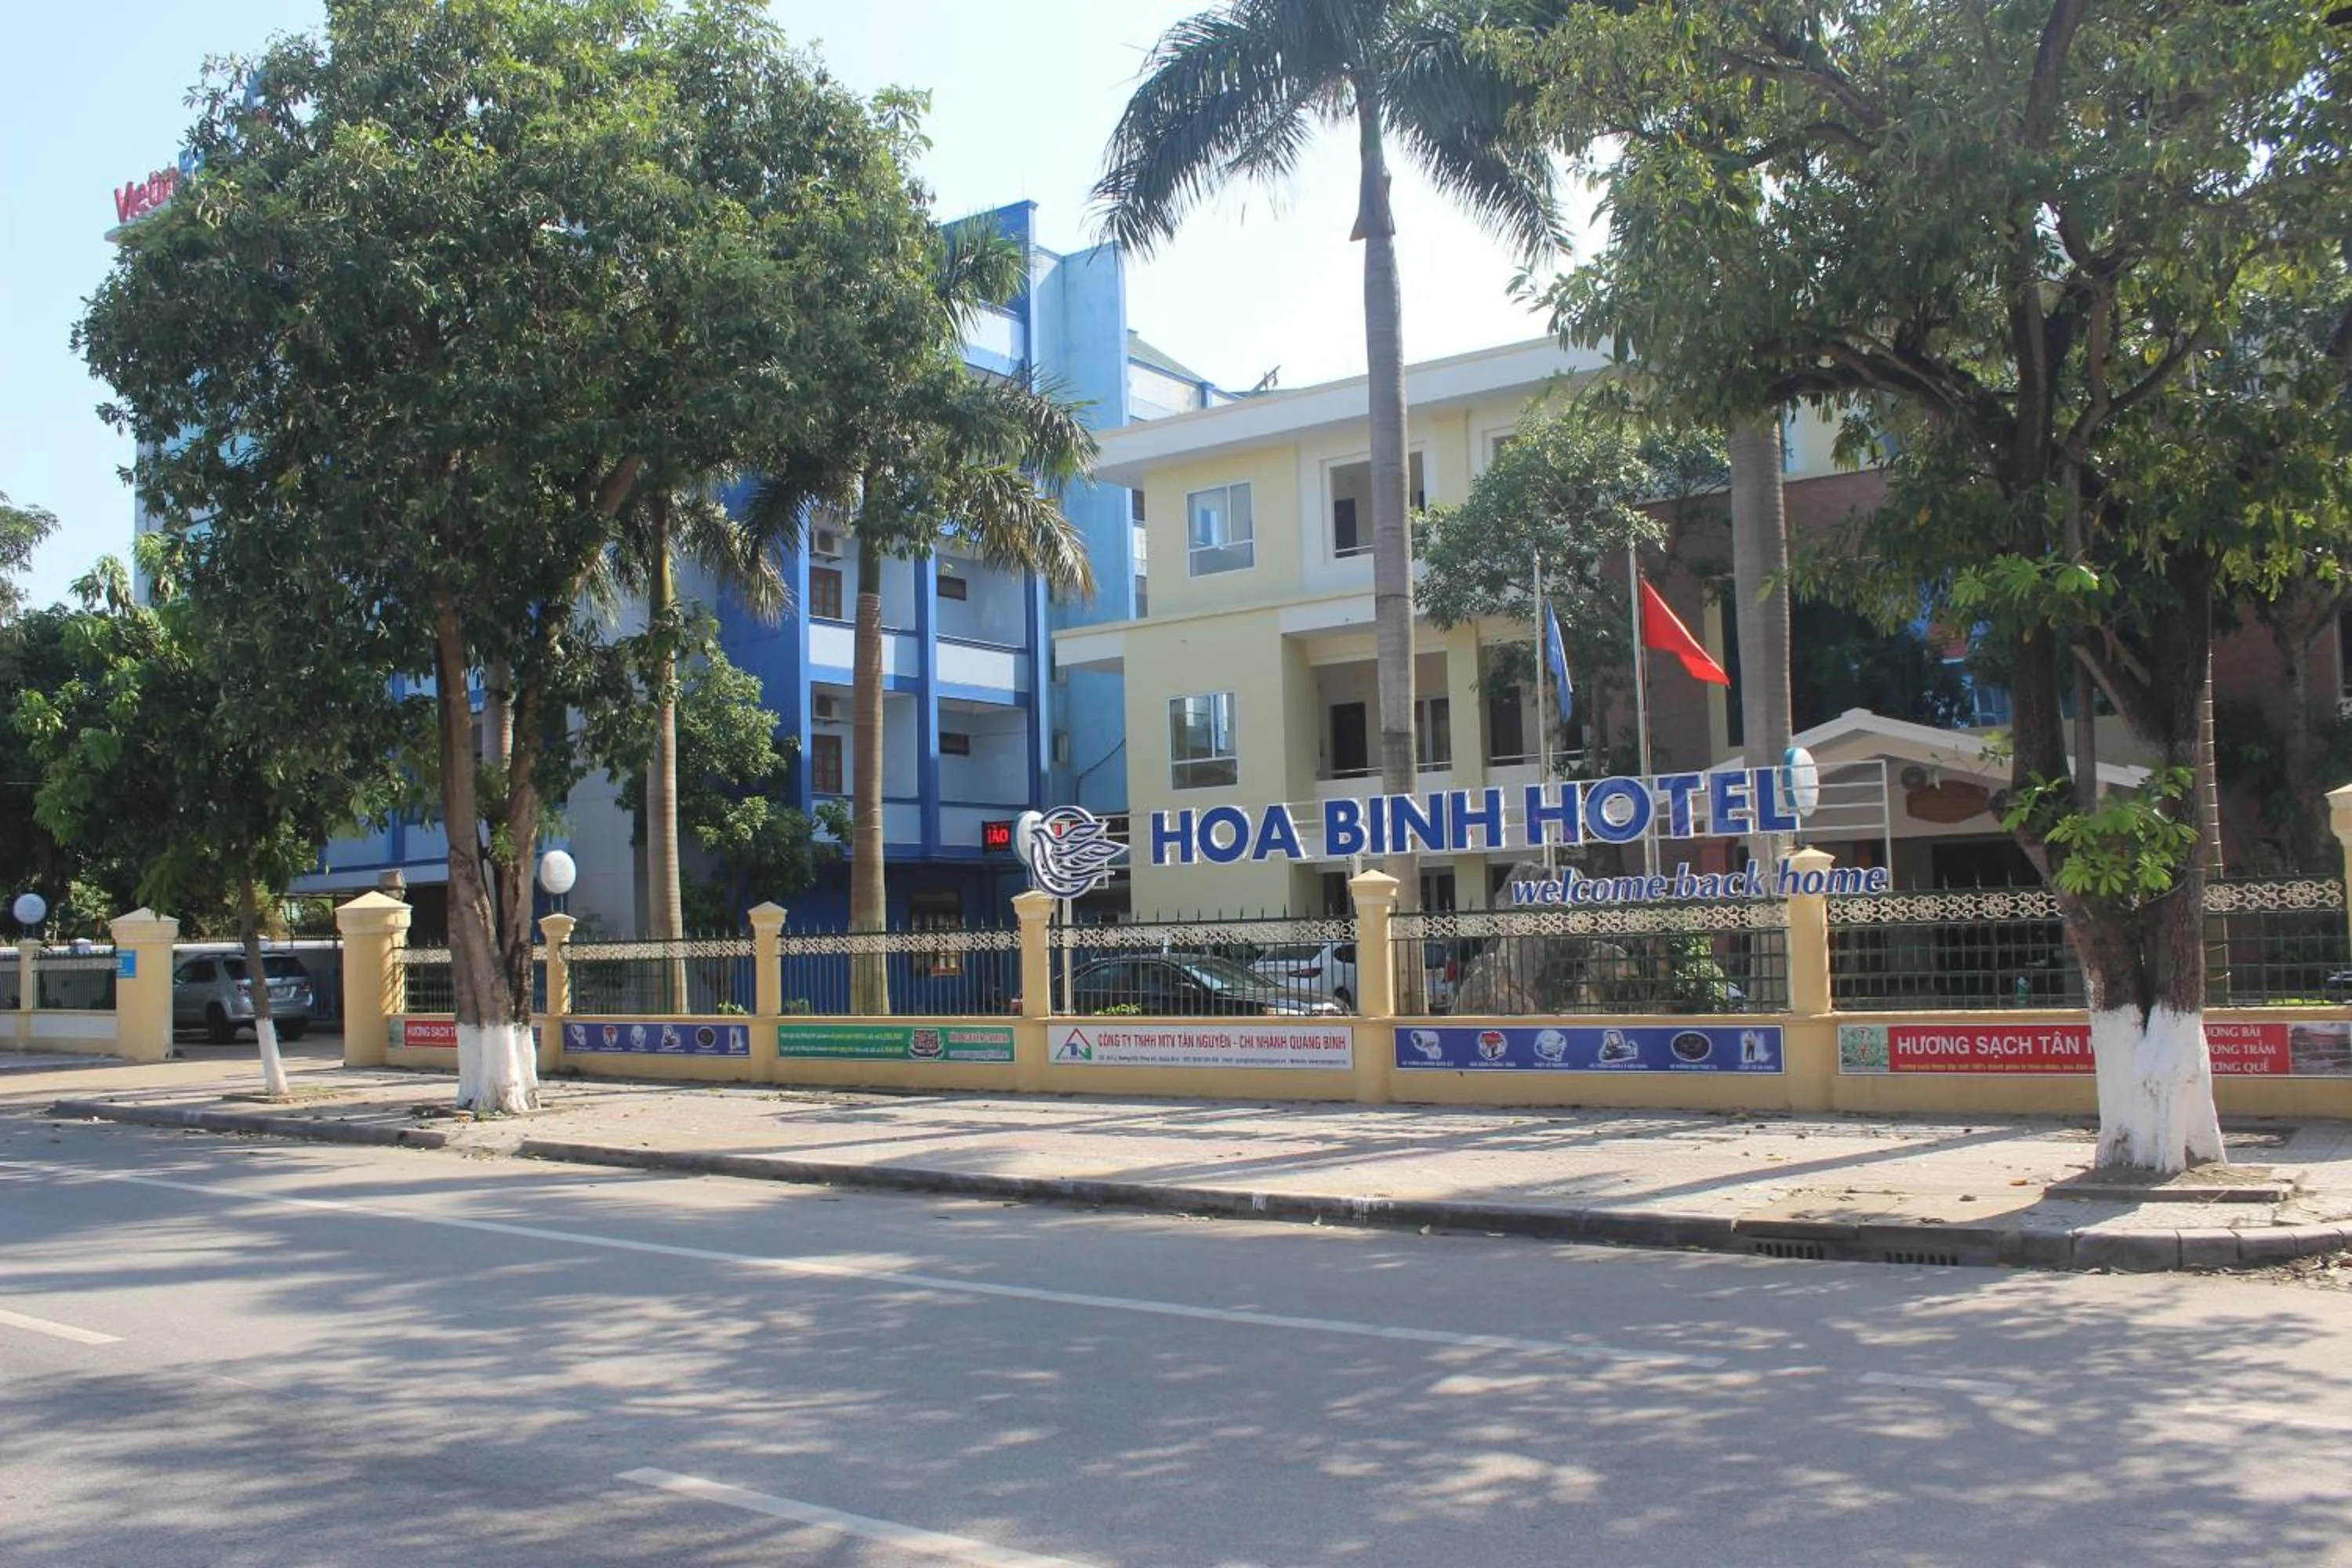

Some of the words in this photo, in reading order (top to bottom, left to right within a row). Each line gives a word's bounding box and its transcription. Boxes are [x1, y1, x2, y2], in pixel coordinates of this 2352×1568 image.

[1151, 802, 1308, 866] HOA
[1323, 786, 1506, 858] BINH
[1524, 765, 1801, 848] HOTEL
[1511, 868, 1668, 906] welcome
[1673, 858, 1766, 899] back
[1777, 858, 1889, 896] home
[1976, 1035, 2033, 1058] SẠCH
[2038, 1031, 2080, 1054] TÂN
